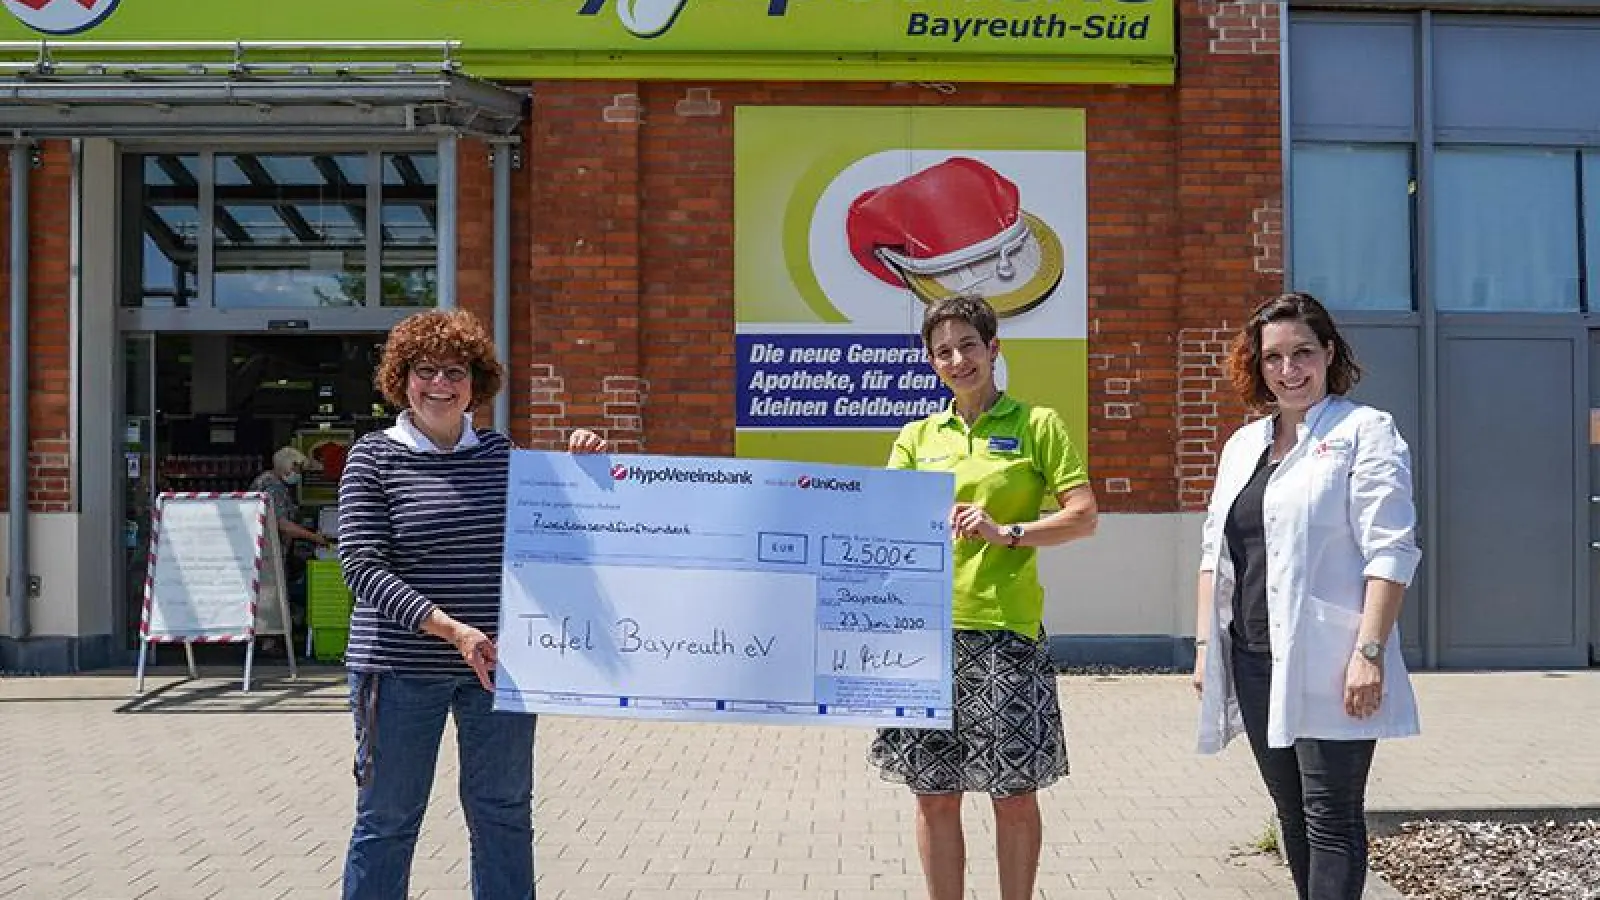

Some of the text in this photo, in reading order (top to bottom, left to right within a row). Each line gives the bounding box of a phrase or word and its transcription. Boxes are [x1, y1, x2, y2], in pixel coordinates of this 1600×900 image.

[906, 13, 1150, 42] Bayreuth-Süd
[750, 343, 930, 363] Die neue Generat
[749, 370, 936, 394] Apotheke, für den
[750, 397, 828, 416] kleinen
[629, 466, 752, 485] HypoVereinsbank
[811, 478, 861, 492] UniCredit
[771, 543, 795, 553] EUR
[837, 588, 903, 605] Bayreuth
[893, 615, 925, 629] 2020
[517, 613, 595, 660] Tafel
[615, 617, 735, 660] Bayreuth
